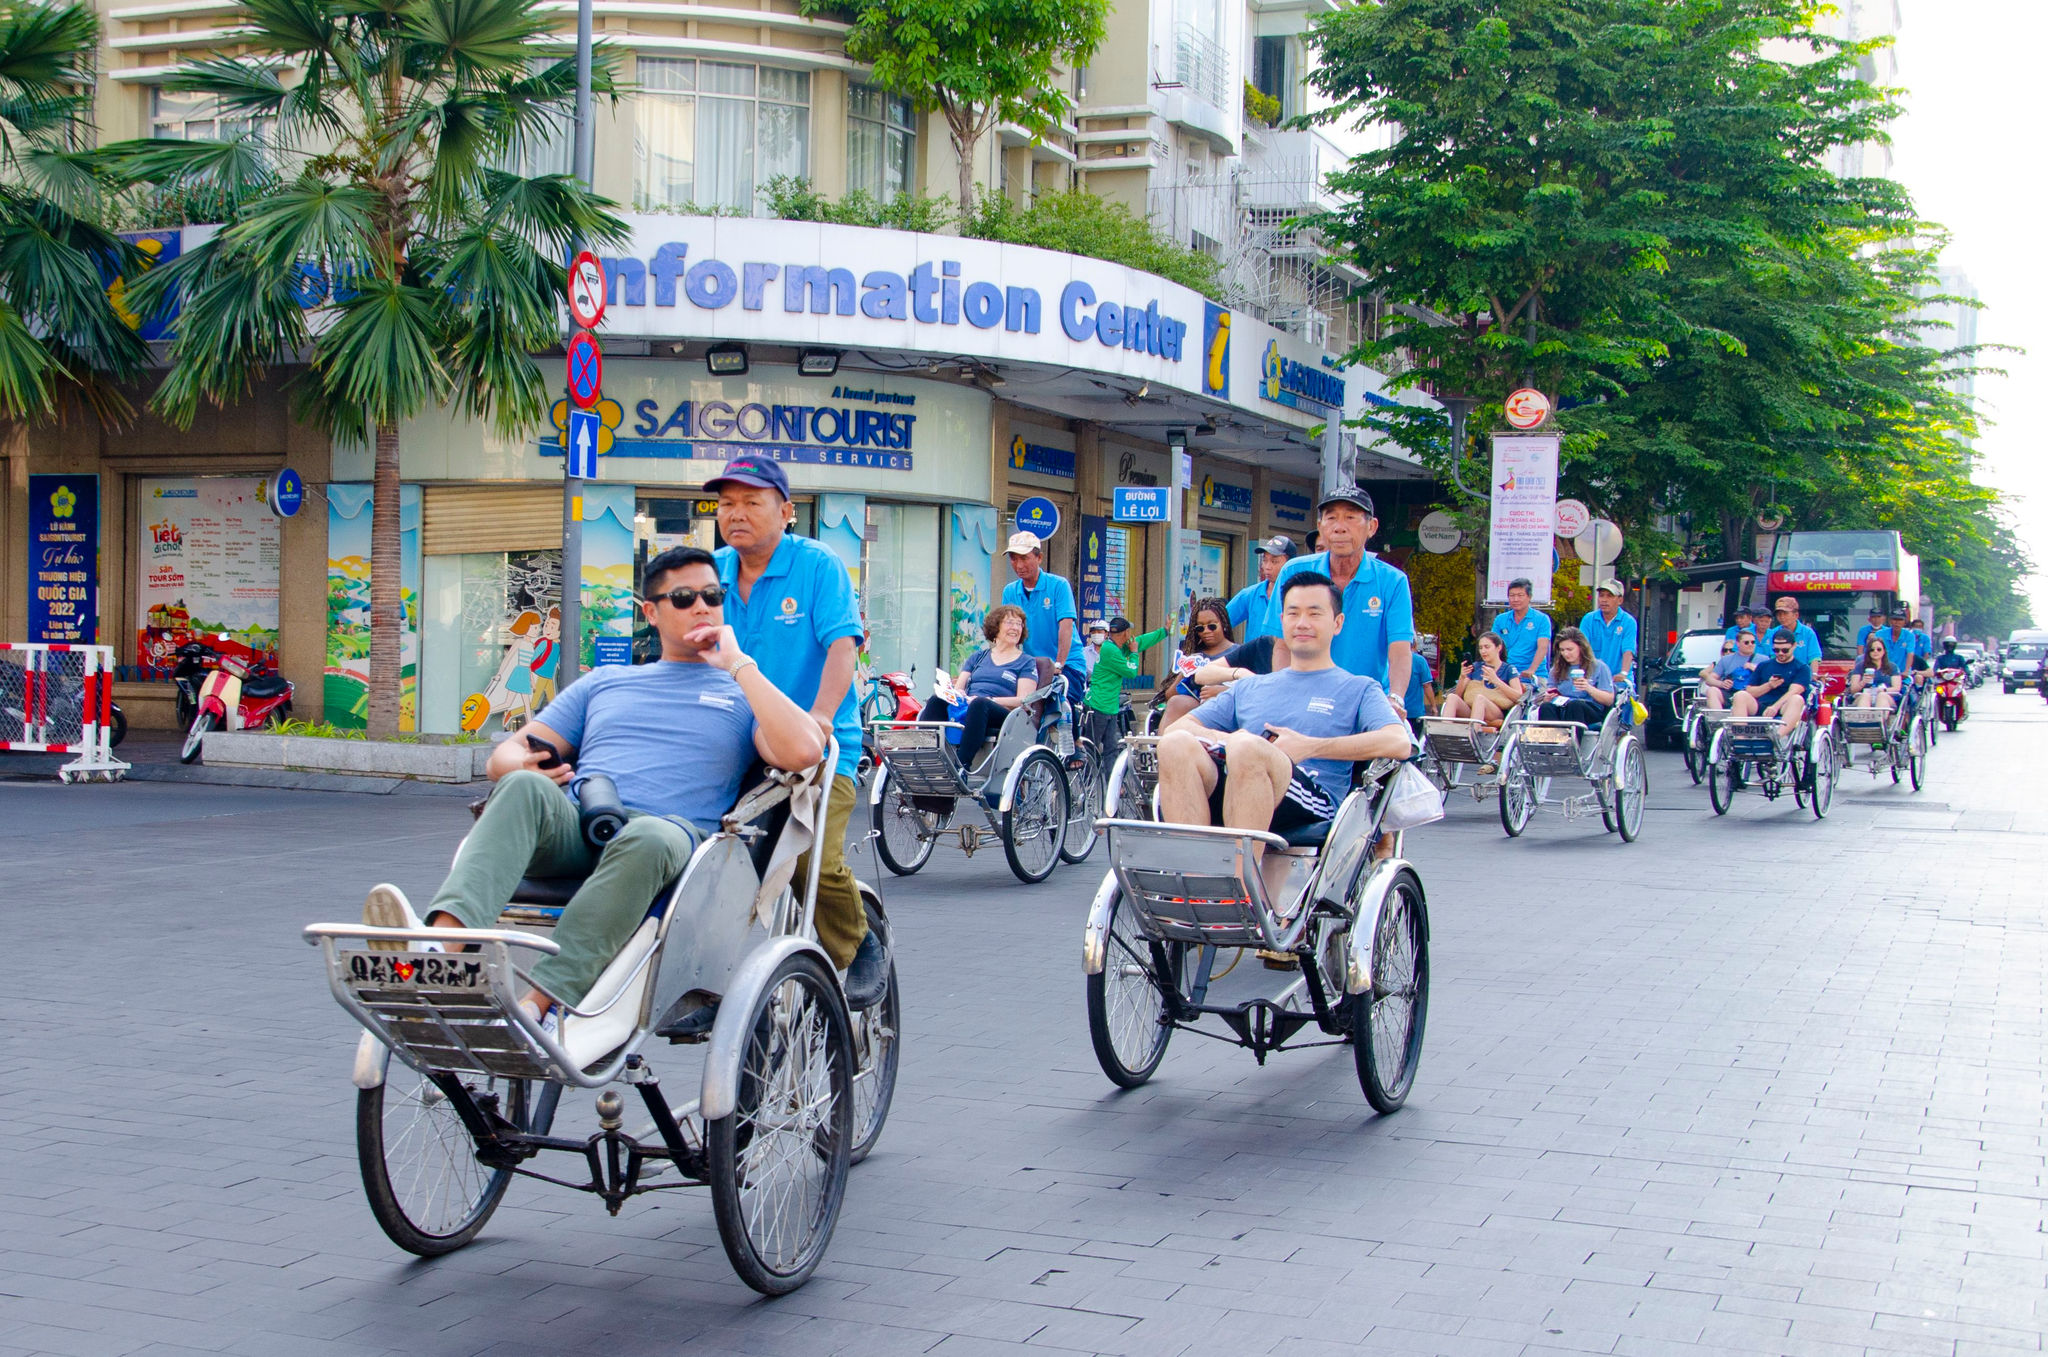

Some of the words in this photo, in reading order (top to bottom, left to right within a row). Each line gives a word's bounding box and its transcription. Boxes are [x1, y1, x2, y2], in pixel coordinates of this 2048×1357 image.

[565, 241, 1041, 333] nformation
[1060, 280, 1187, 362] Center
[634, 399, 917, 450] SAIGONTOURIST
[699, 447, 798, 461] TRAVEL
[819, 451, 911, 468] SERVICE
[1125, 491, 1156, 501] ĐƯỜNG
[1122, 503, 1137, 517] LÊ
[1140, 504, 1160, 519] LỢI
[148, 517, 181, 544] Tết
[148, 574, 167, 582] TOUR
[1783, 573, 1806, 582] HO
[1808, 572, 1835, 580] CHI
[1838, 572, 1878, 580] MINH
[37, 583, 66, 601] QUỐC
[68, 586, 87, 600] GIA
[49, 601, 75, 616] 2022
